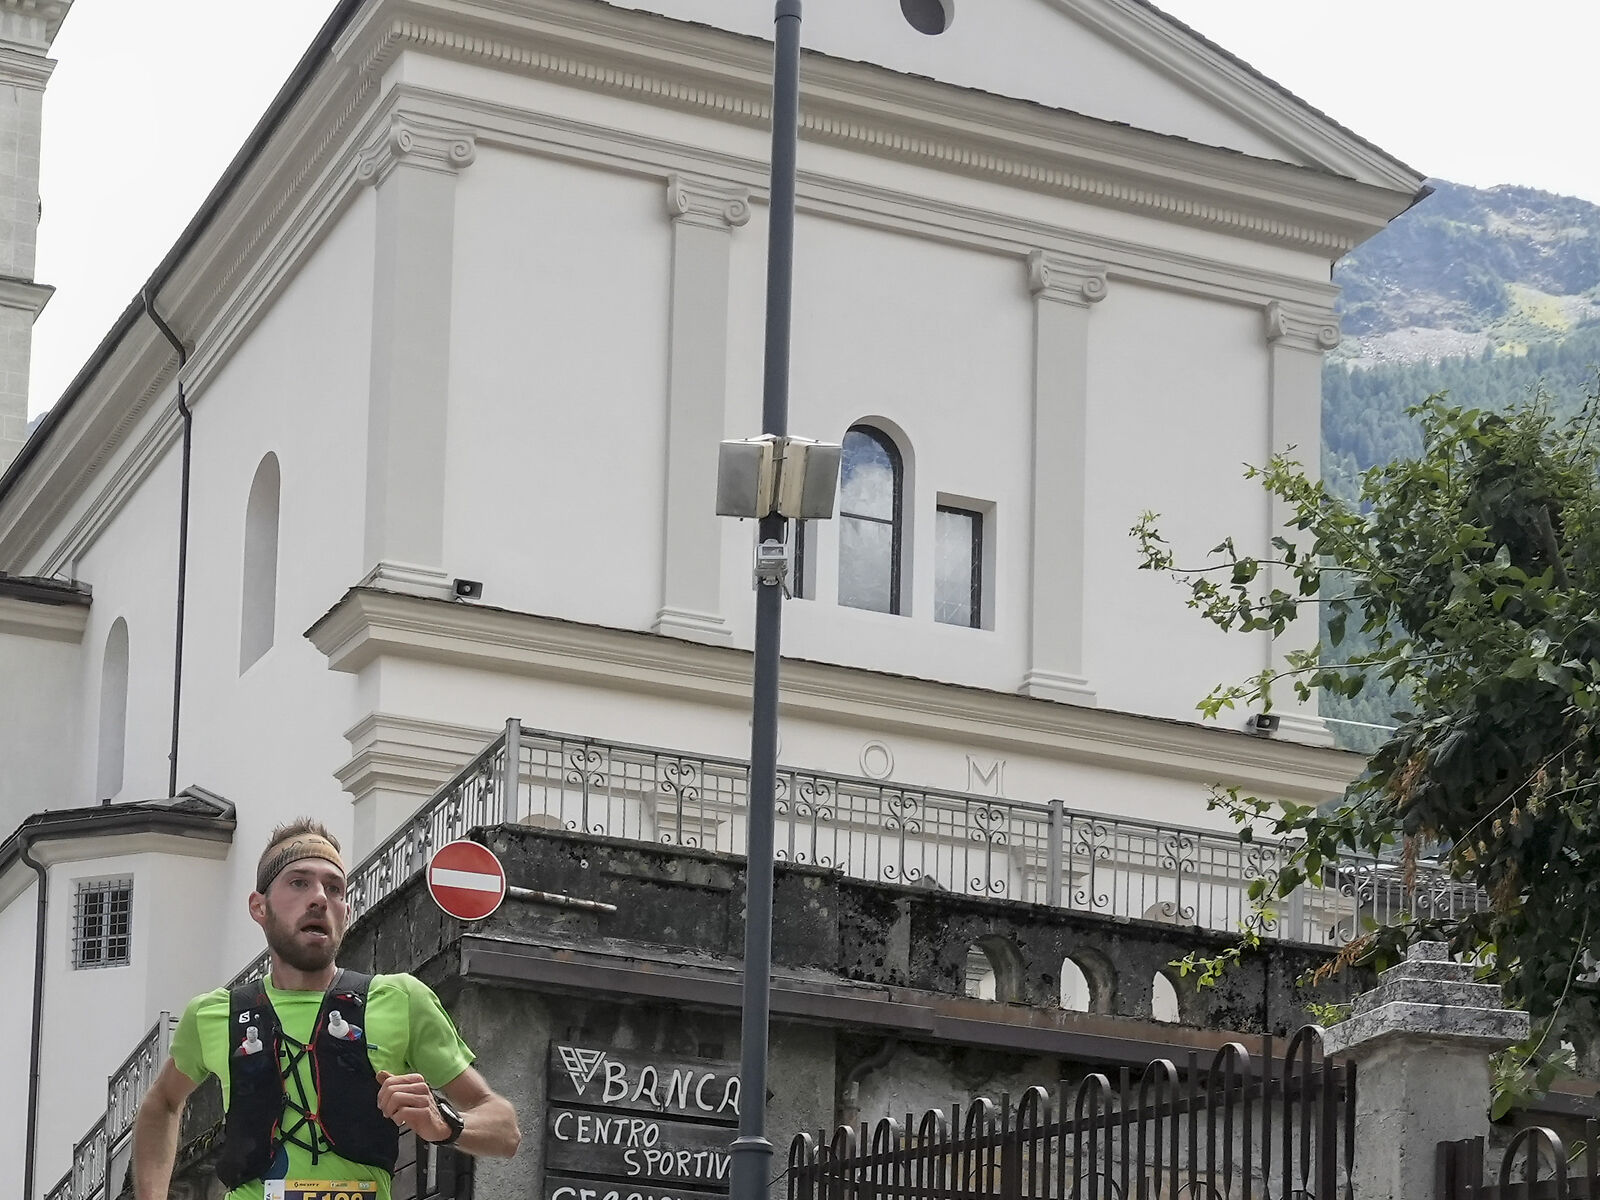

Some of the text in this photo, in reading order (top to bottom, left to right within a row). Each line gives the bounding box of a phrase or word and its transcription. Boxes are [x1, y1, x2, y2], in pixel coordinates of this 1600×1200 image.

[602, 1059, 742, 1115] BANCA
[554, 1112, 660, 1148] CENTRO
[623, 1150, 732, 1180] SPORTIV
